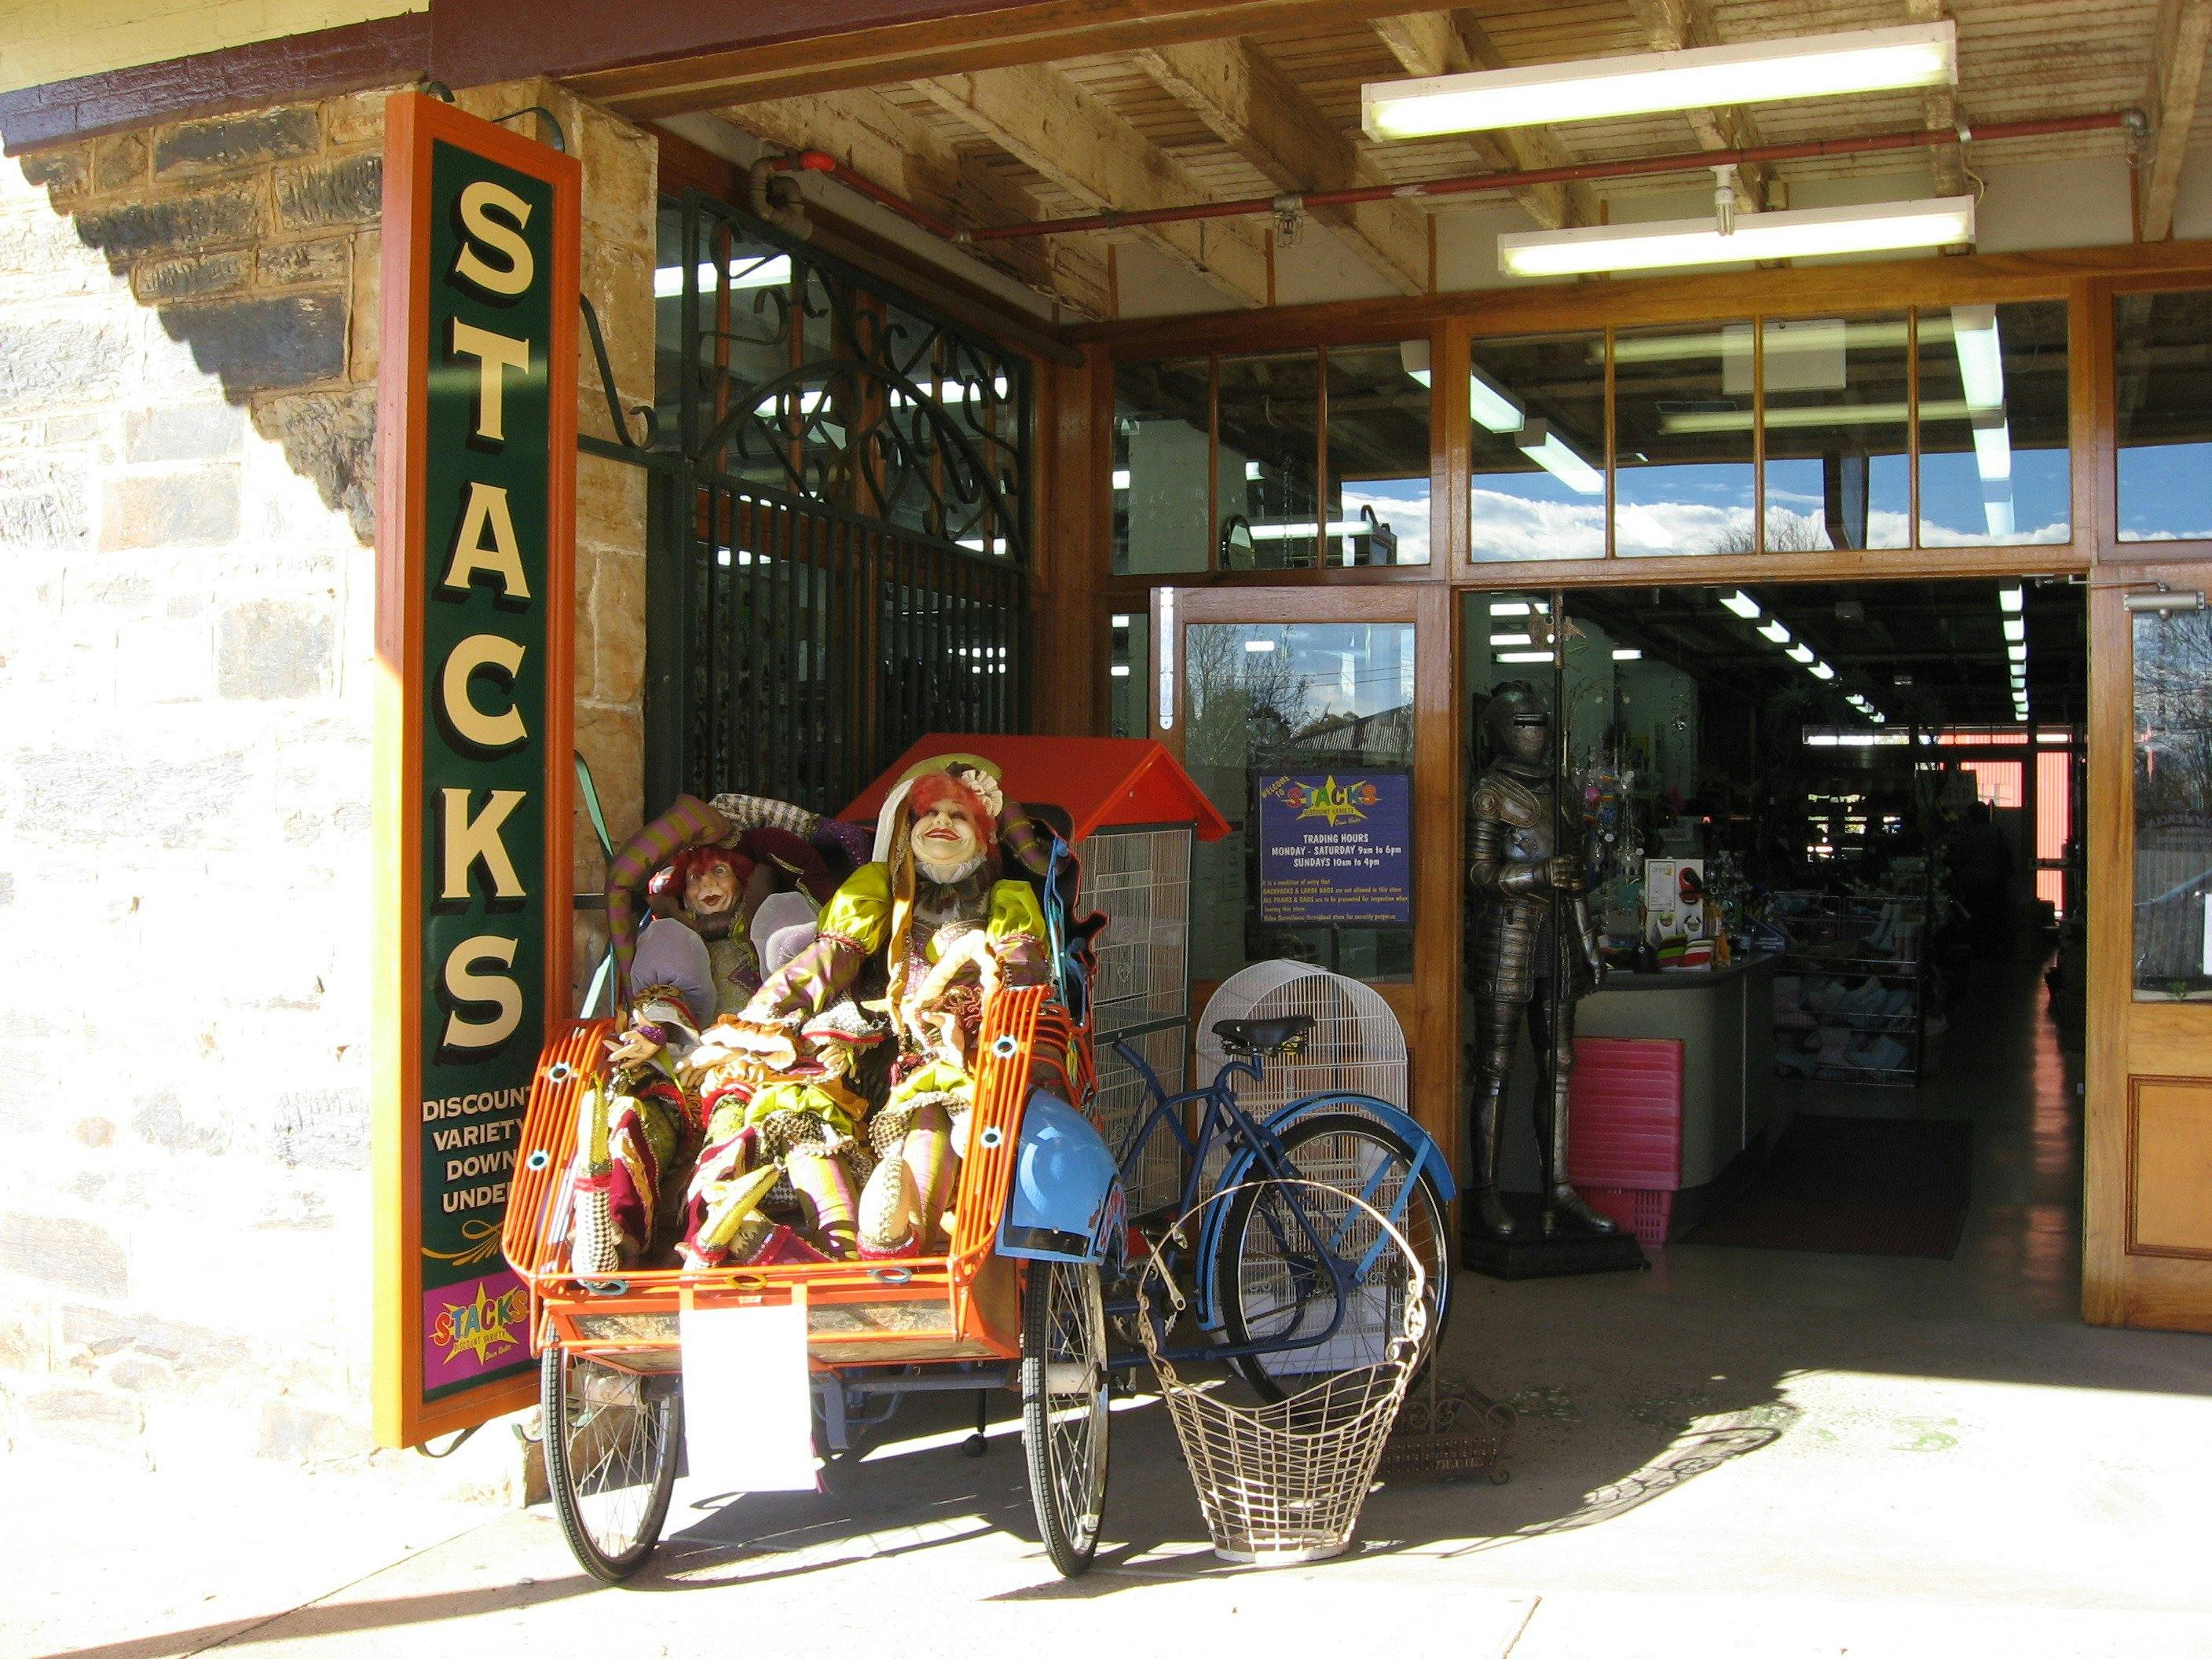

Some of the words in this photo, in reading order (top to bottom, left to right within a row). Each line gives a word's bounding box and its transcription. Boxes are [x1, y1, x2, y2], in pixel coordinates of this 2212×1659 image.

[441, 180, 535, 1049] STACKS
[1275, 789, 1285, 798] TO
[1286, 784, 1376, 808] STACKS
[1303, 833, 1339, 844] TRADING
[1341, 833, 1369, 843] HOURS
[1271, 846, 1306, 856] MONDAY
[1313, 844, 1356, 855] SATURDAY
[1357, 846, 1373, 855] 9am
[1375, 845, 1383, 854] to
[1385, 844, 1401, 856] 6pm
[1293, 857, 1331, 867] SUNDAYS
[1332, 858, 1352, 866] 10am
[1353, 858, 1361, 866] to
[1364, 857, 1380, 869] 4pm
[442, 1181, 513, 1214] UNDE
[433, 1289, 528, 1347] STACKS
